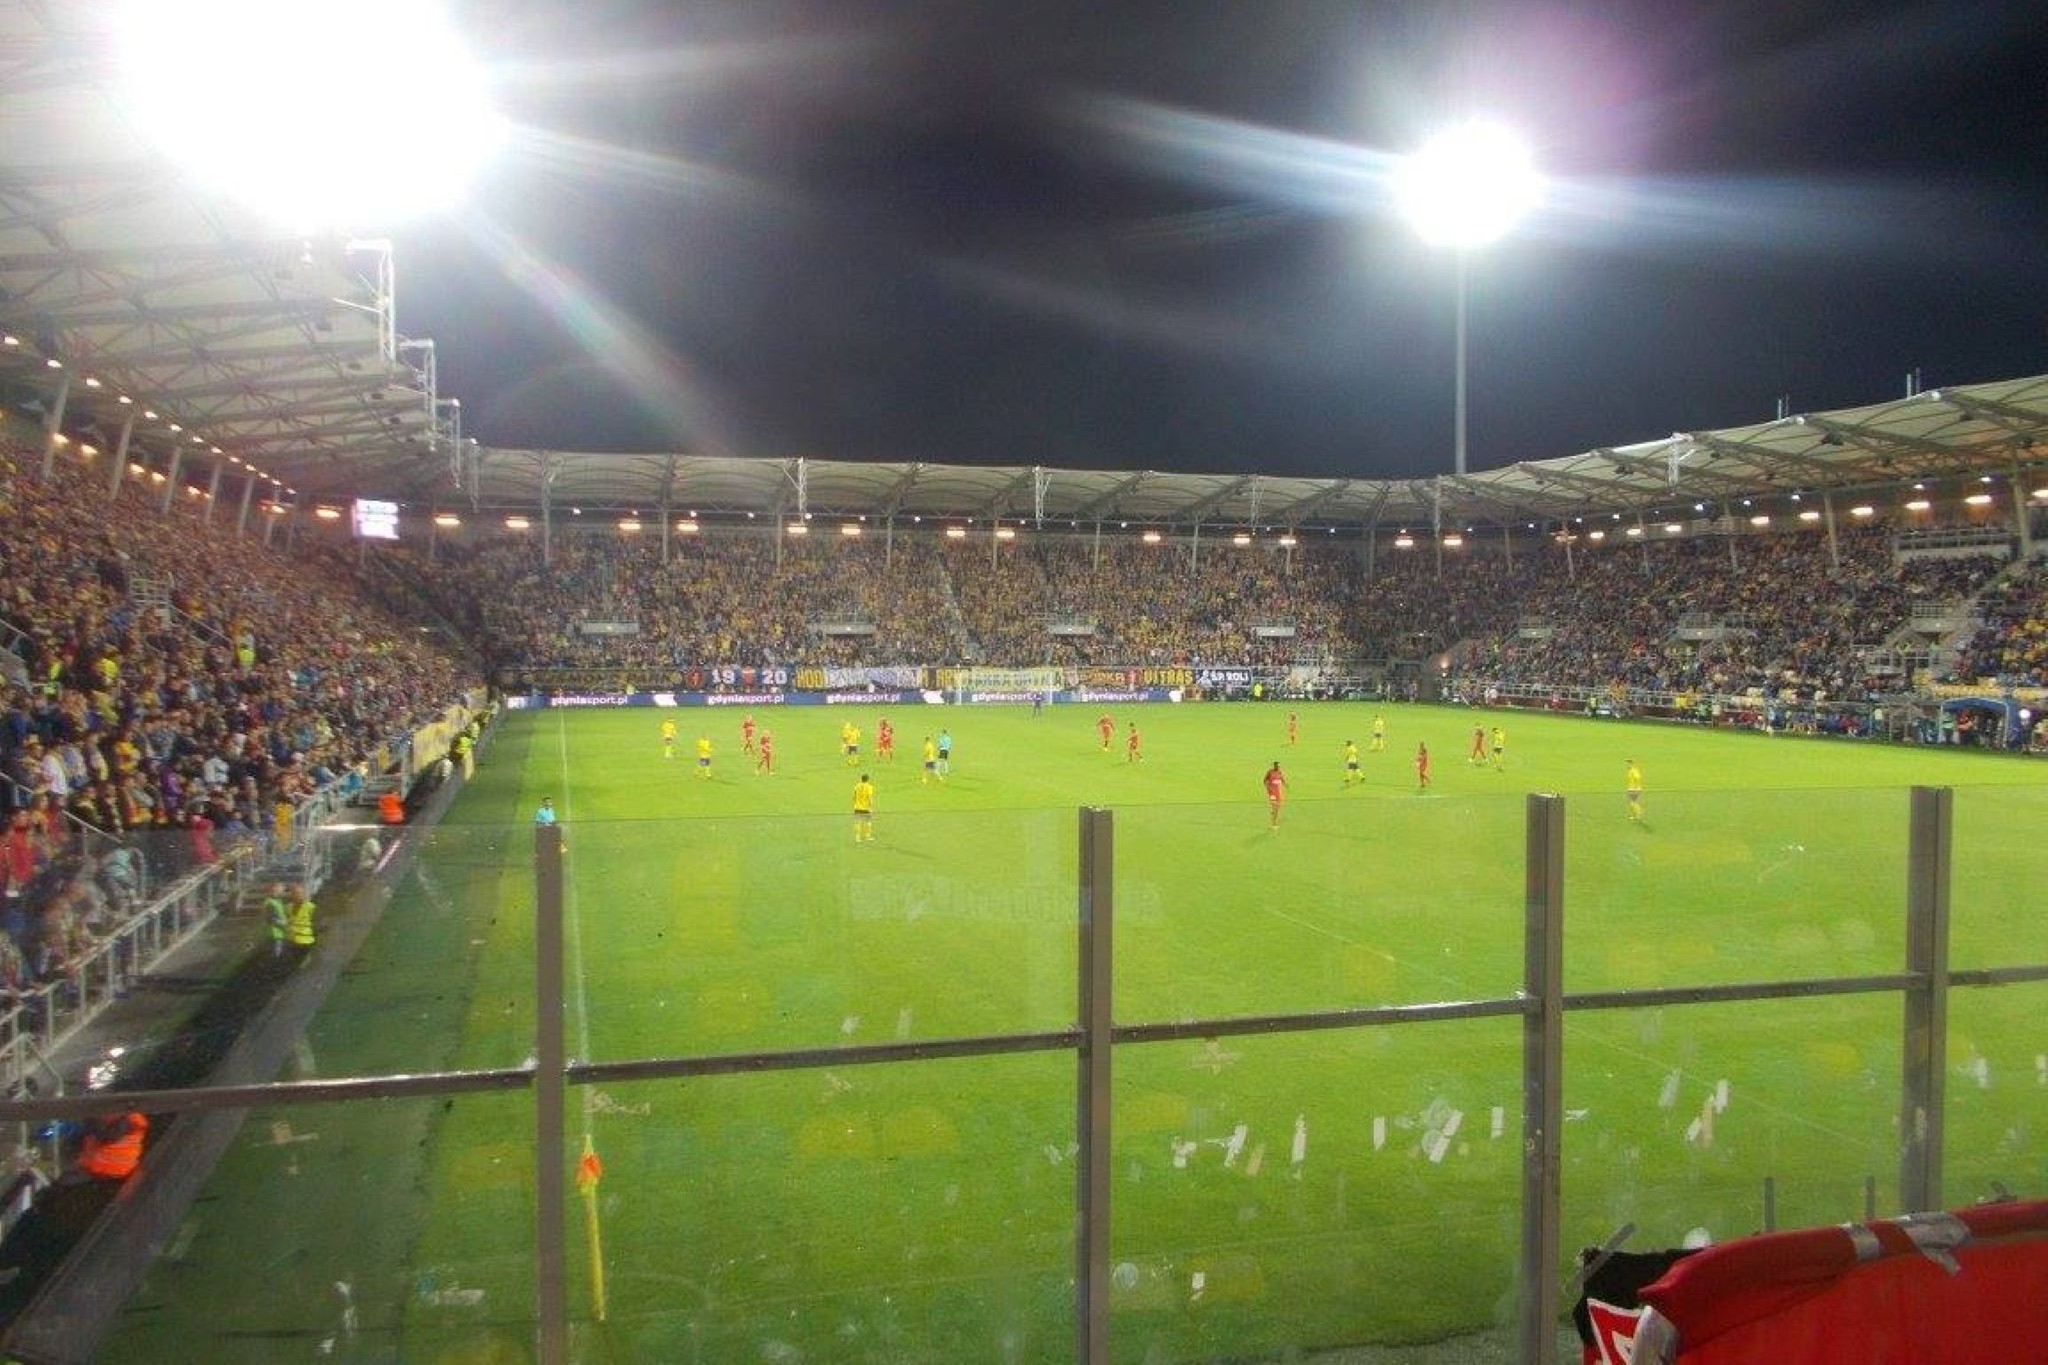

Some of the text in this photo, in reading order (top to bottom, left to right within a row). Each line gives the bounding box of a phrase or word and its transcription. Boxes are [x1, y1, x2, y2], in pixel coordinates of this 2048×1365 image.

[711, 668, 787, 685] 19 20
[708, 693, 785, 705] gdyniasport.pl
